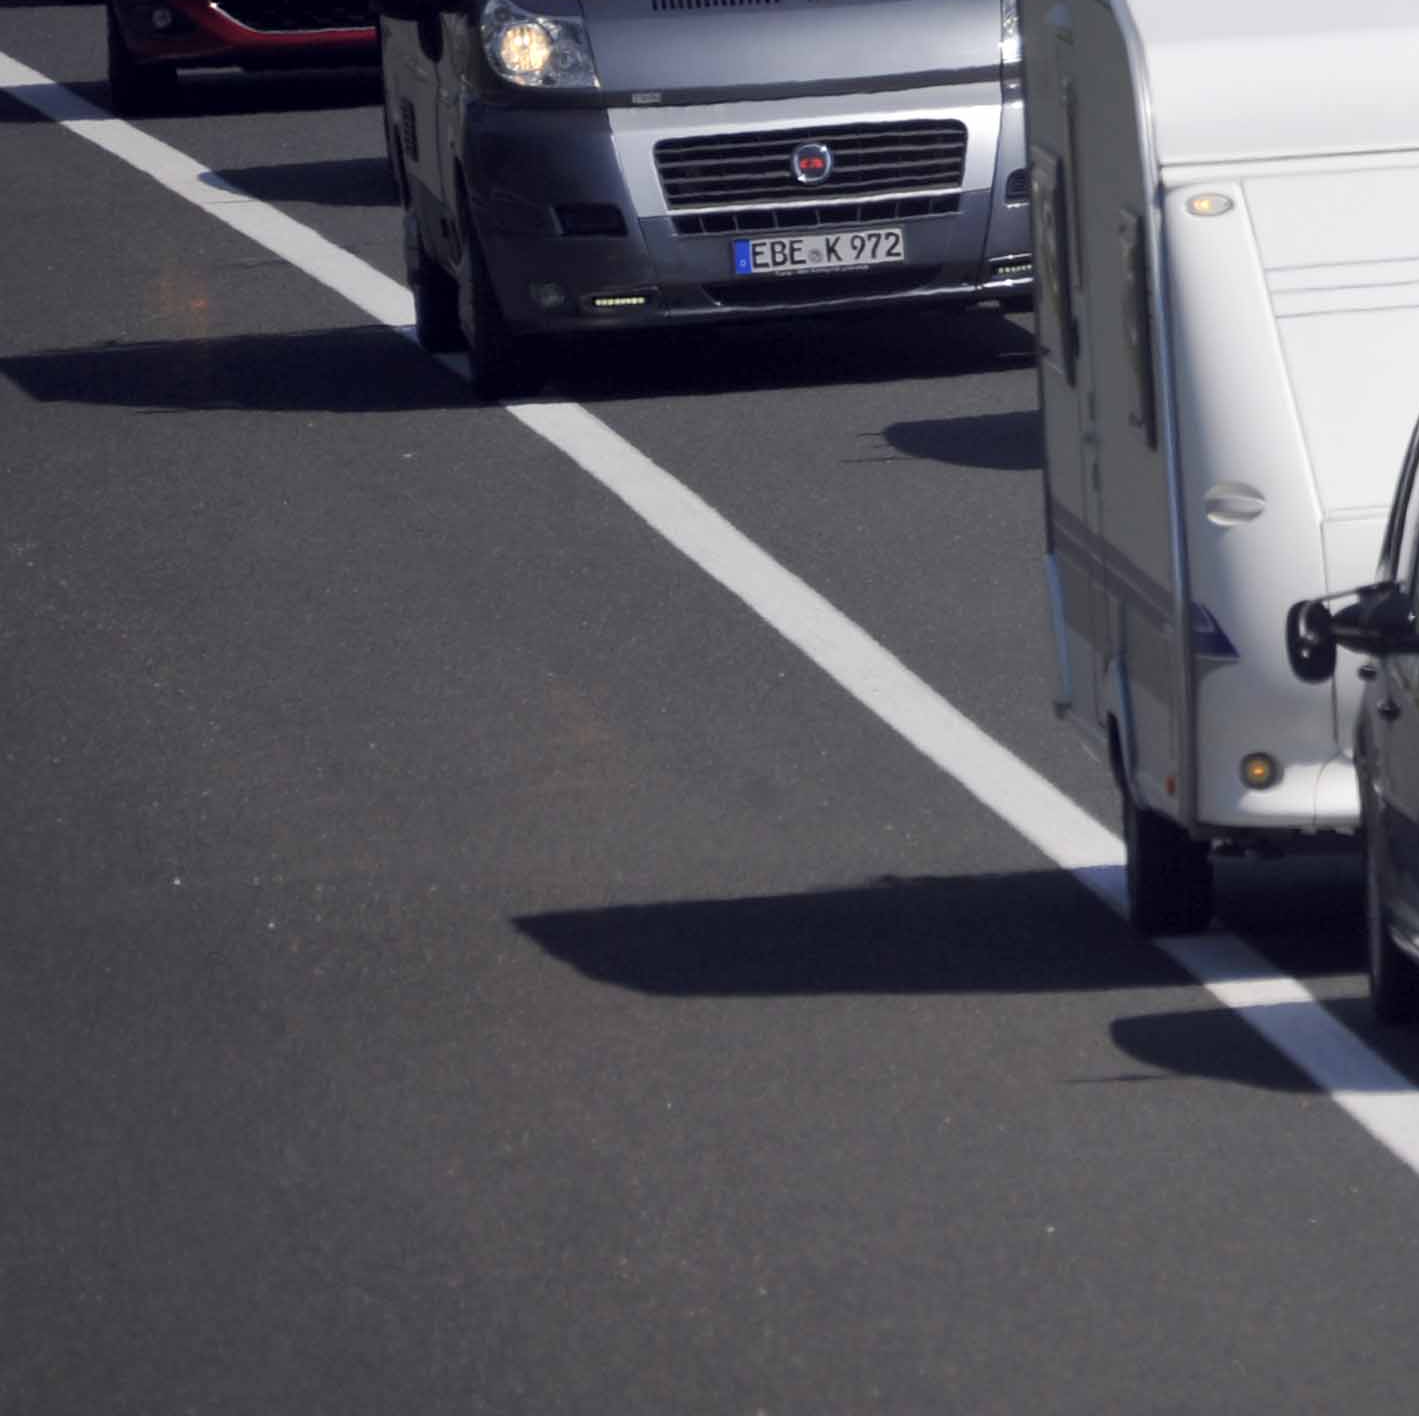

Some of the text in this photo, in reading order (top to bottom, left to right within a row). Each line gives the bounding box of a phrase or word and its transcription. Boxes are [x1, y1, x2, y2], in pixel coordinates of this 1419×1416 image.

[752, 232, 902, 269] EBE K 972
